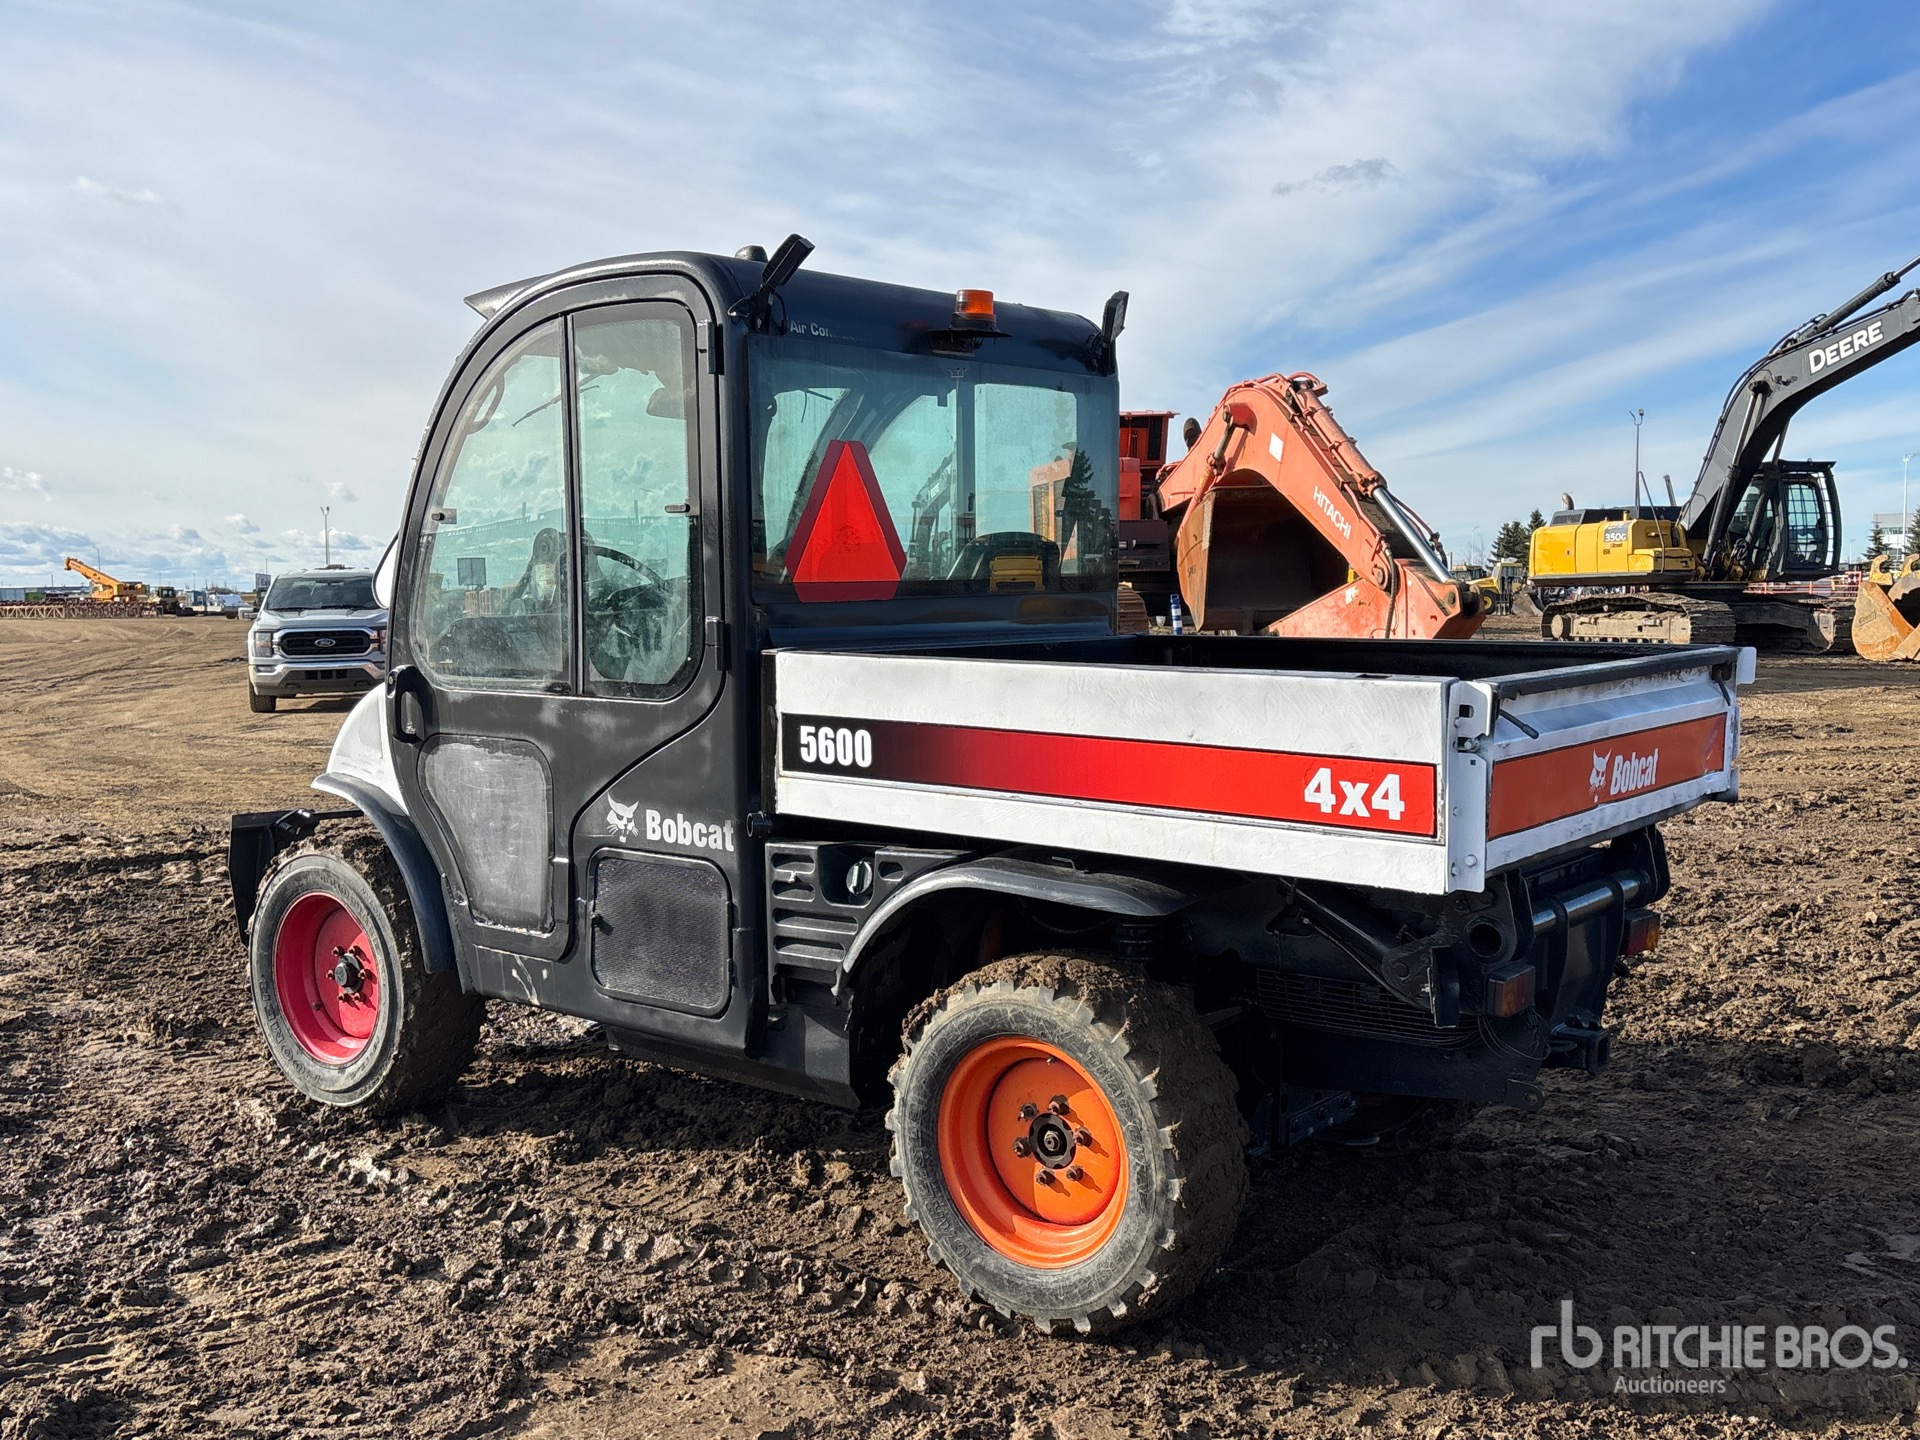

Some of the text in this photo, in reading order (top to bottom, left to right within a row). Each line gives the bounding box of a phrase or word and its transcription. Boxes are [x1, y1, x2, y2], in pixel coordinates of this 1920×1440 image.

[790, 320, 807, 334] Air
[1808, 320, 1884, 374] DEERE
[1313, 485, 1352, 540] HITACHI
[1604, 532, 1627, 542] 350G
[800, 725, 872, 768] 5600
[1304, 767, 1406, 821] 4x4
[1609, 747, 1659, 796] Bobcat
[645, 808, 735, 852] Bobcat
